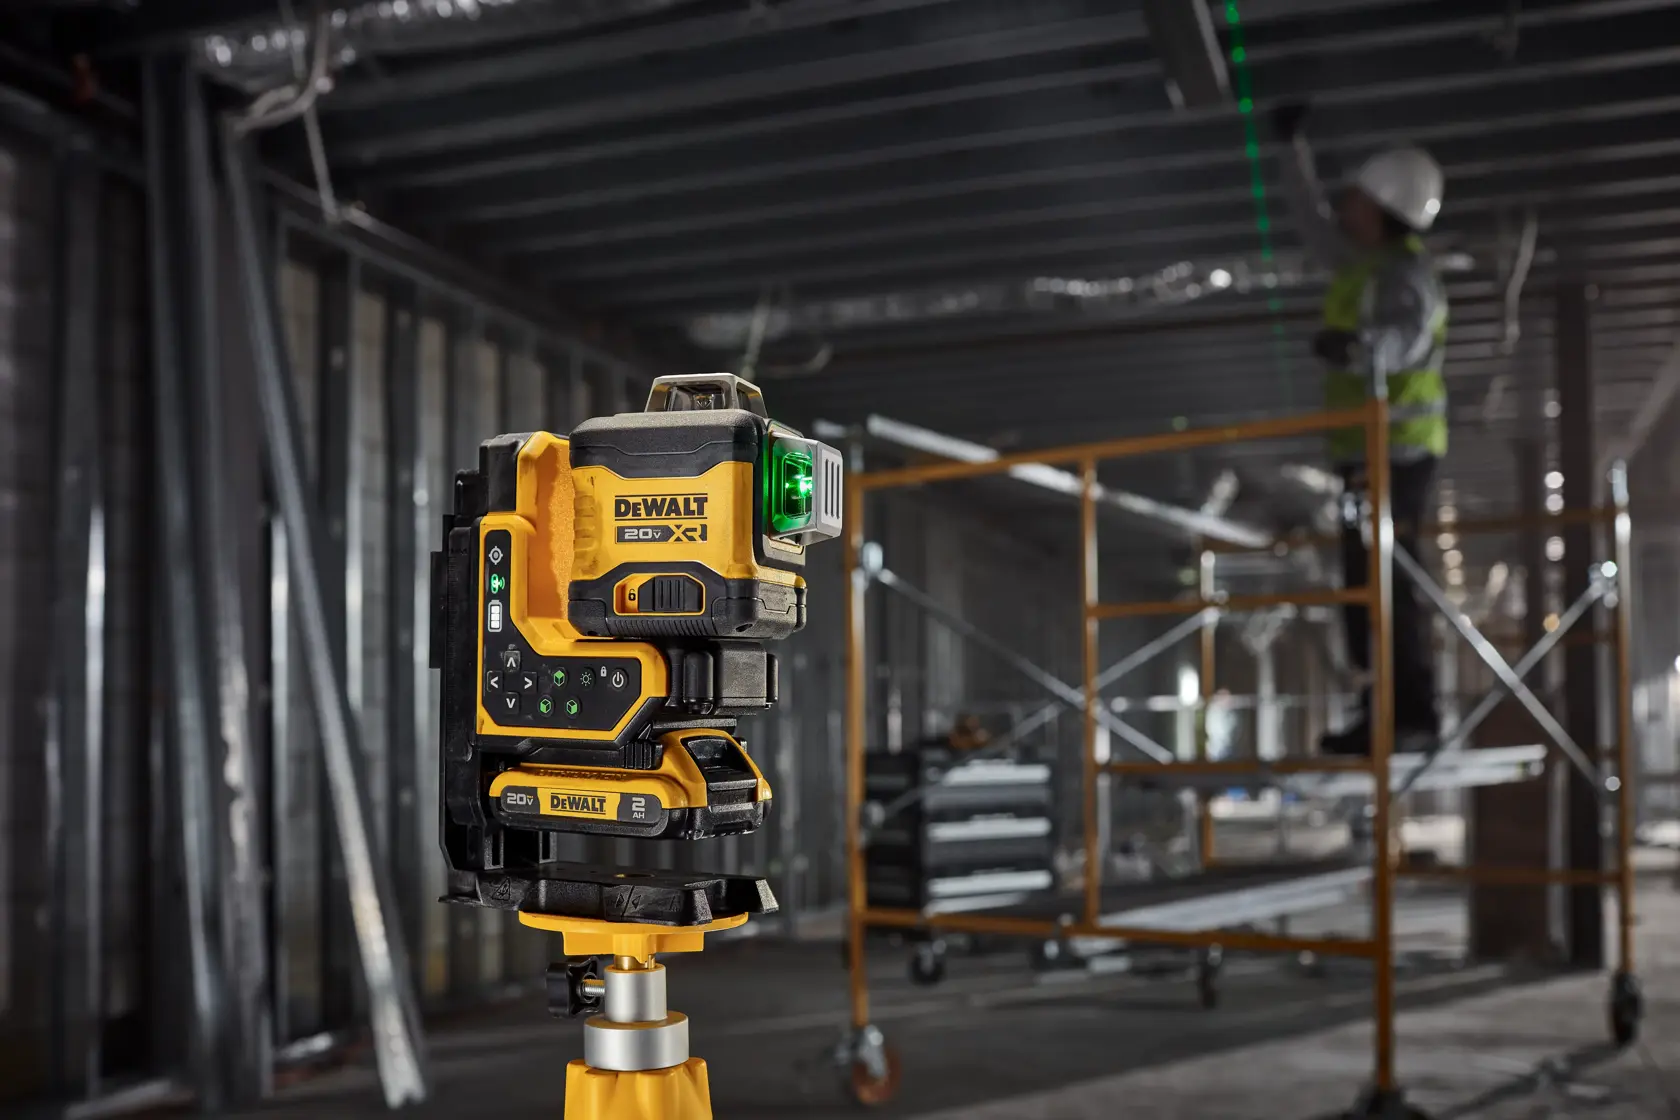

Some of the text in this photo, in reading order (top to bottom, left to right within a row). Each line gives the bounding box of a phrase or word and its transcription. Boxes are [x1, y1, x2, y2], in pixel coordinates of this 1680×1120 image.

[667, 524, 703, 543] XR
[631, 796, 646, 812] 2
[632, 811, 645, 819] AH
